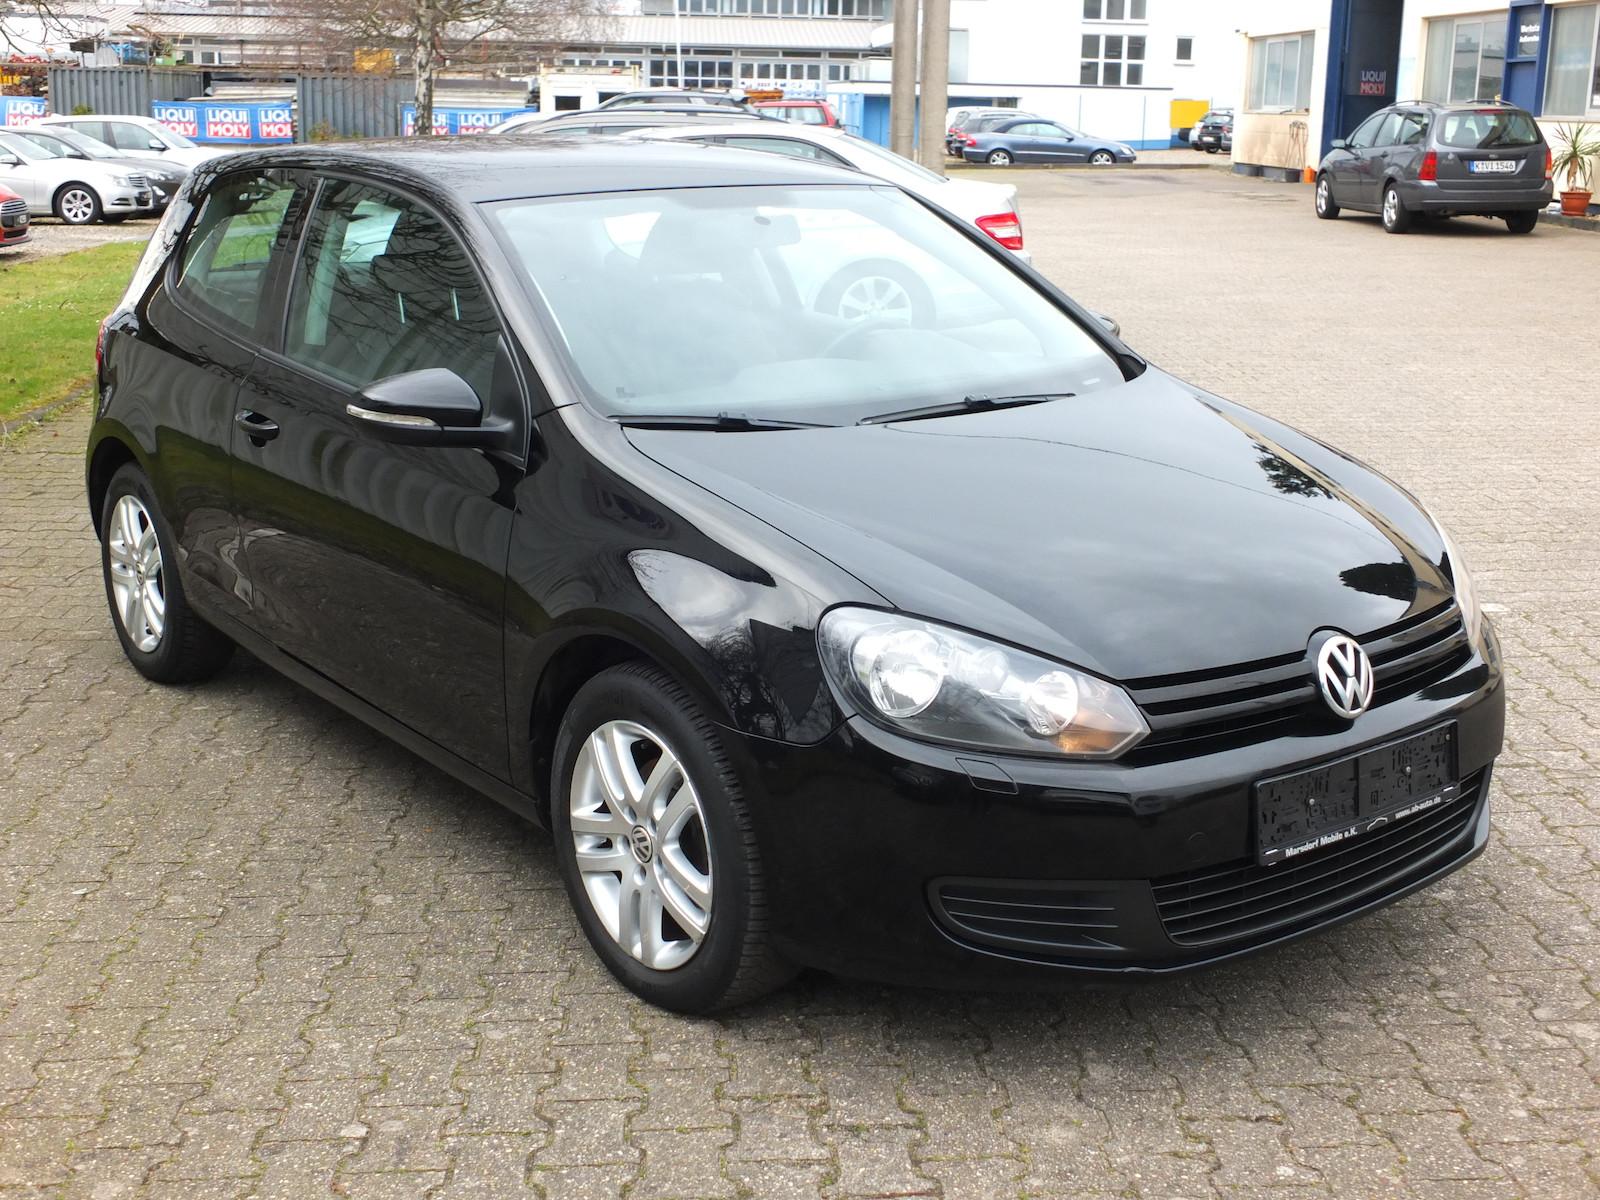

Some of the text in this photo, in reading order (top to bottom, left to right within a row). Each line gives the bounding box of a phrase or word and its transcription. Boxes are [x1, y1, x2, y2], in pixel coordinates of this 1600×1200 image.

[1360, 82, 1385, 95] MOLY
[9, 102, 45, 116] LIQU
[154, 108, 195, 121] LIQUI
[208, 109, 248, 123] LIQUI
[261, 109, 292, 123] LIQU
[164, 123, 196, 136] OLY
[208, 123, 249, 137] MOLY
[262, 123, 292, 137] MOL
[1285, 839, 1319, 857] Marsdorf
[1320, 832, 1343, 846] Mobile
